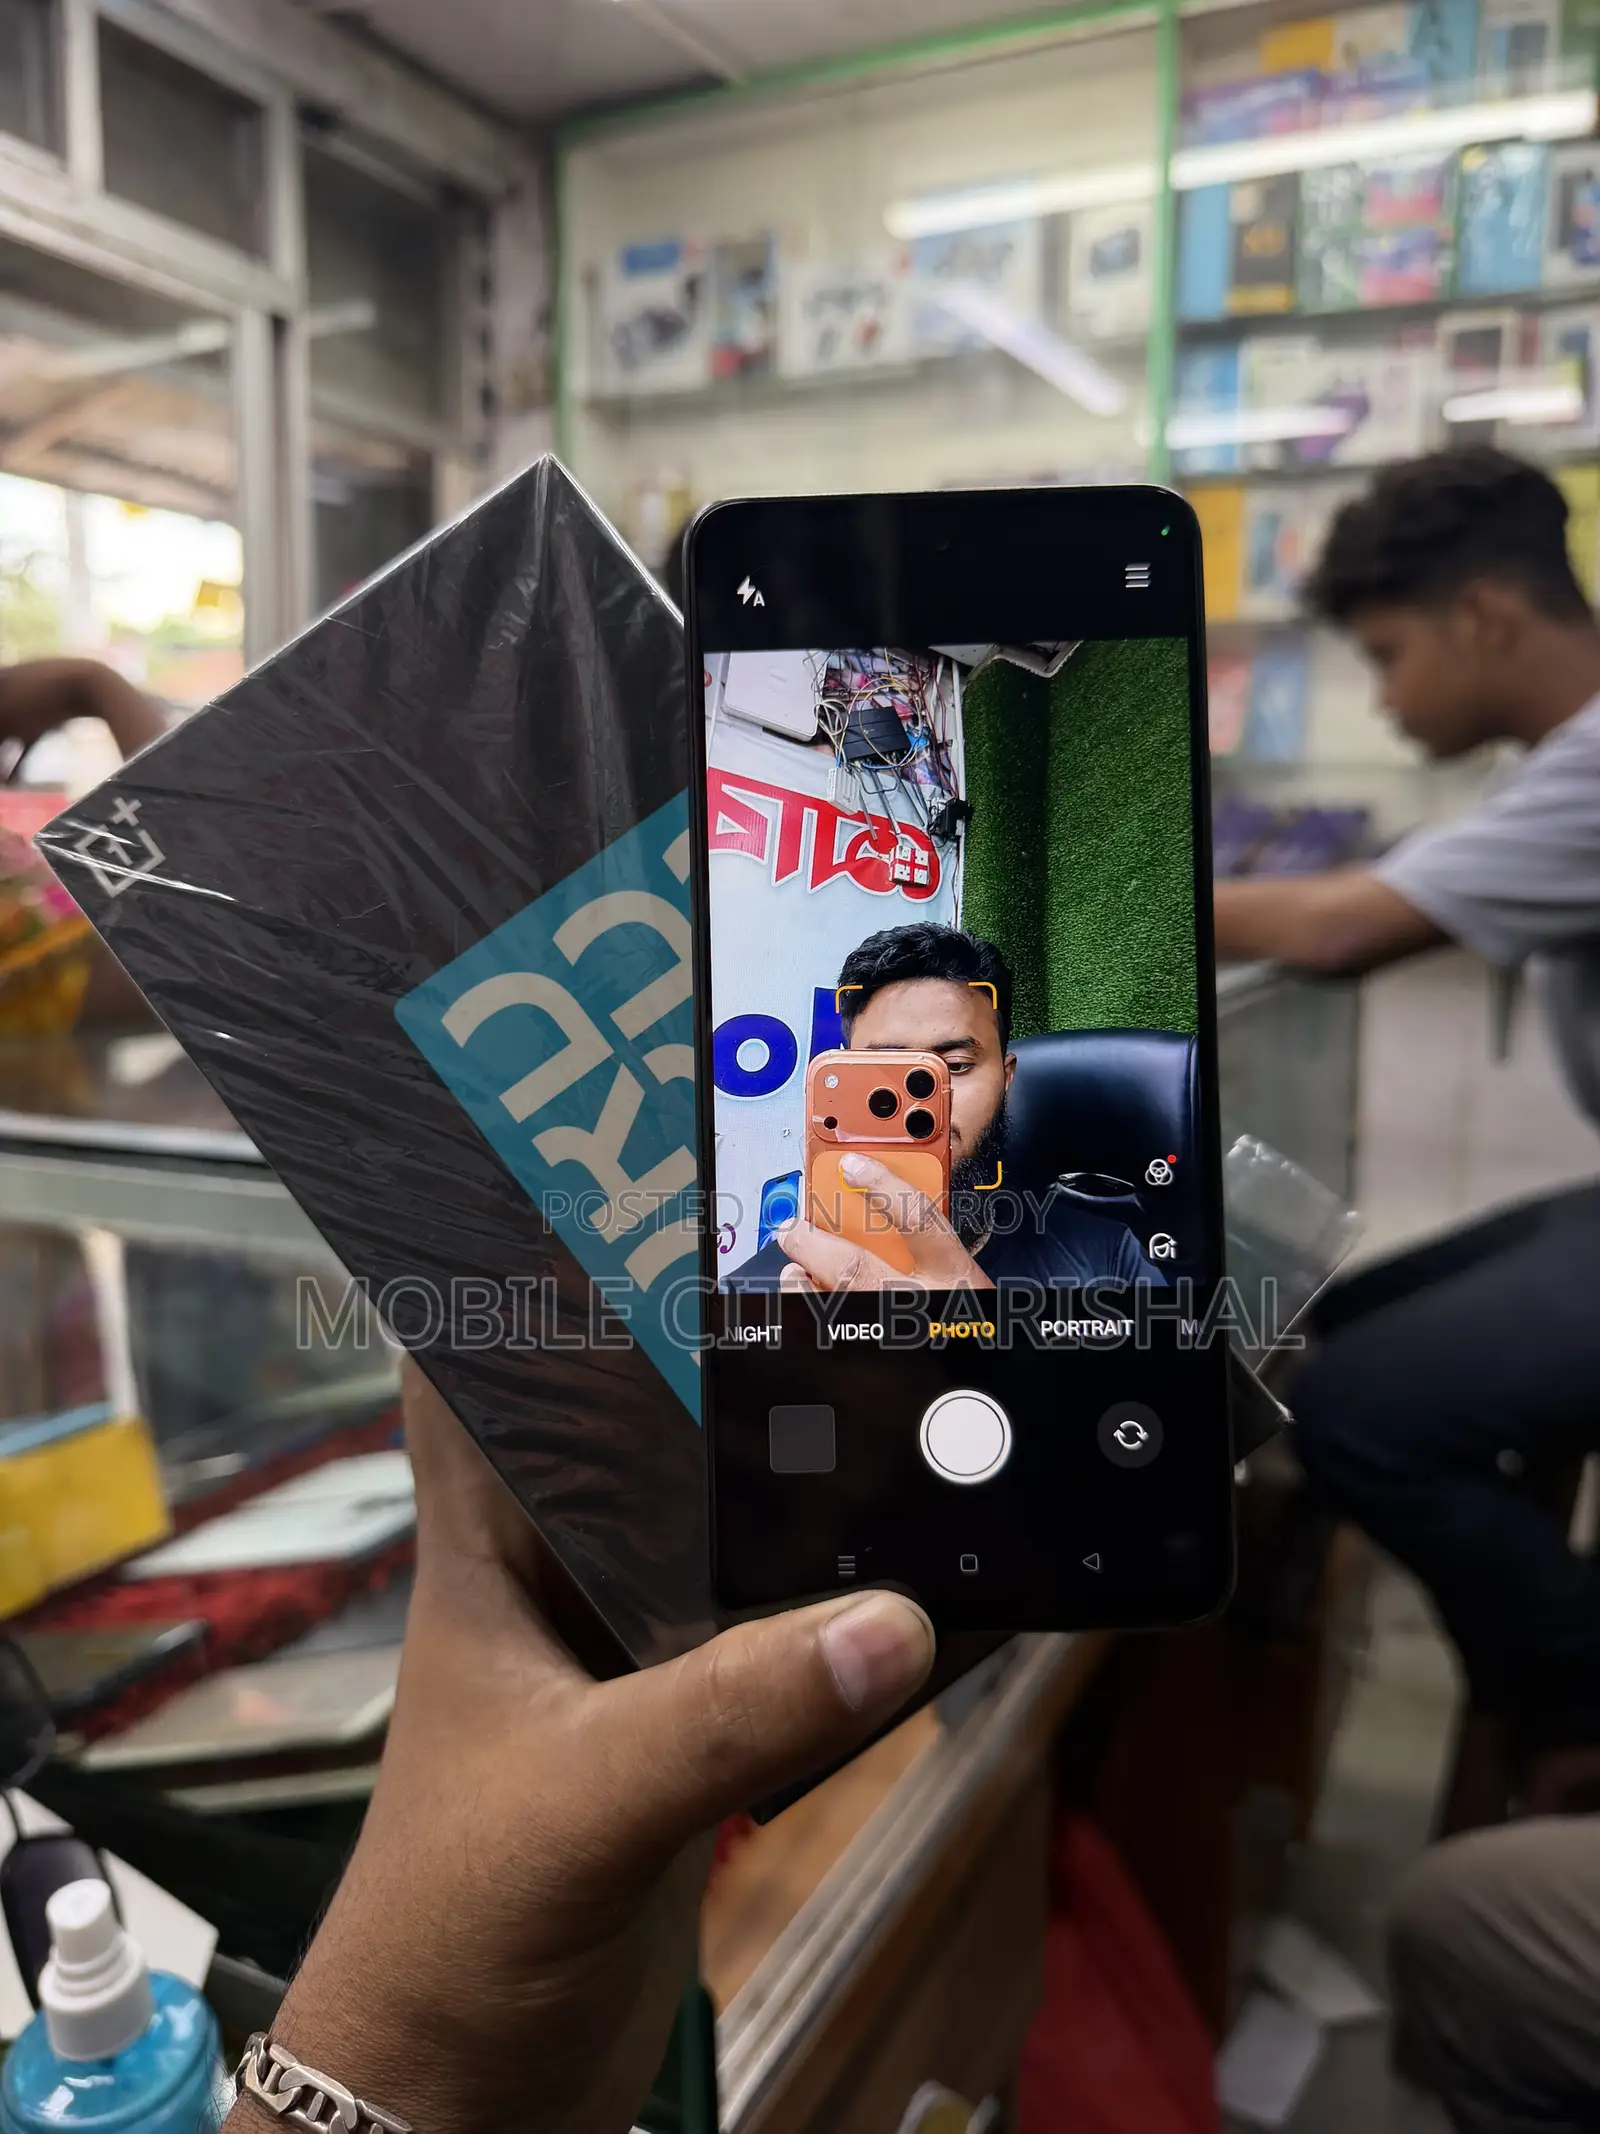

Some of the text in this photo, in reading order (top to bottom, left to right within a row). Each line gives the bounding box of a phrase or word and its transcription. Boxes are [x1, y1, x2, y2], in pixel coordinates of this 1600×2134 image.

[726, 1325, 782, 1342] NIGHT
[827, 1323, 885, 1341] VIDEO
[929, 1321, 995, 1339] PHOTO
[1041, 1319, 1135, 1337] PORTRAIT
